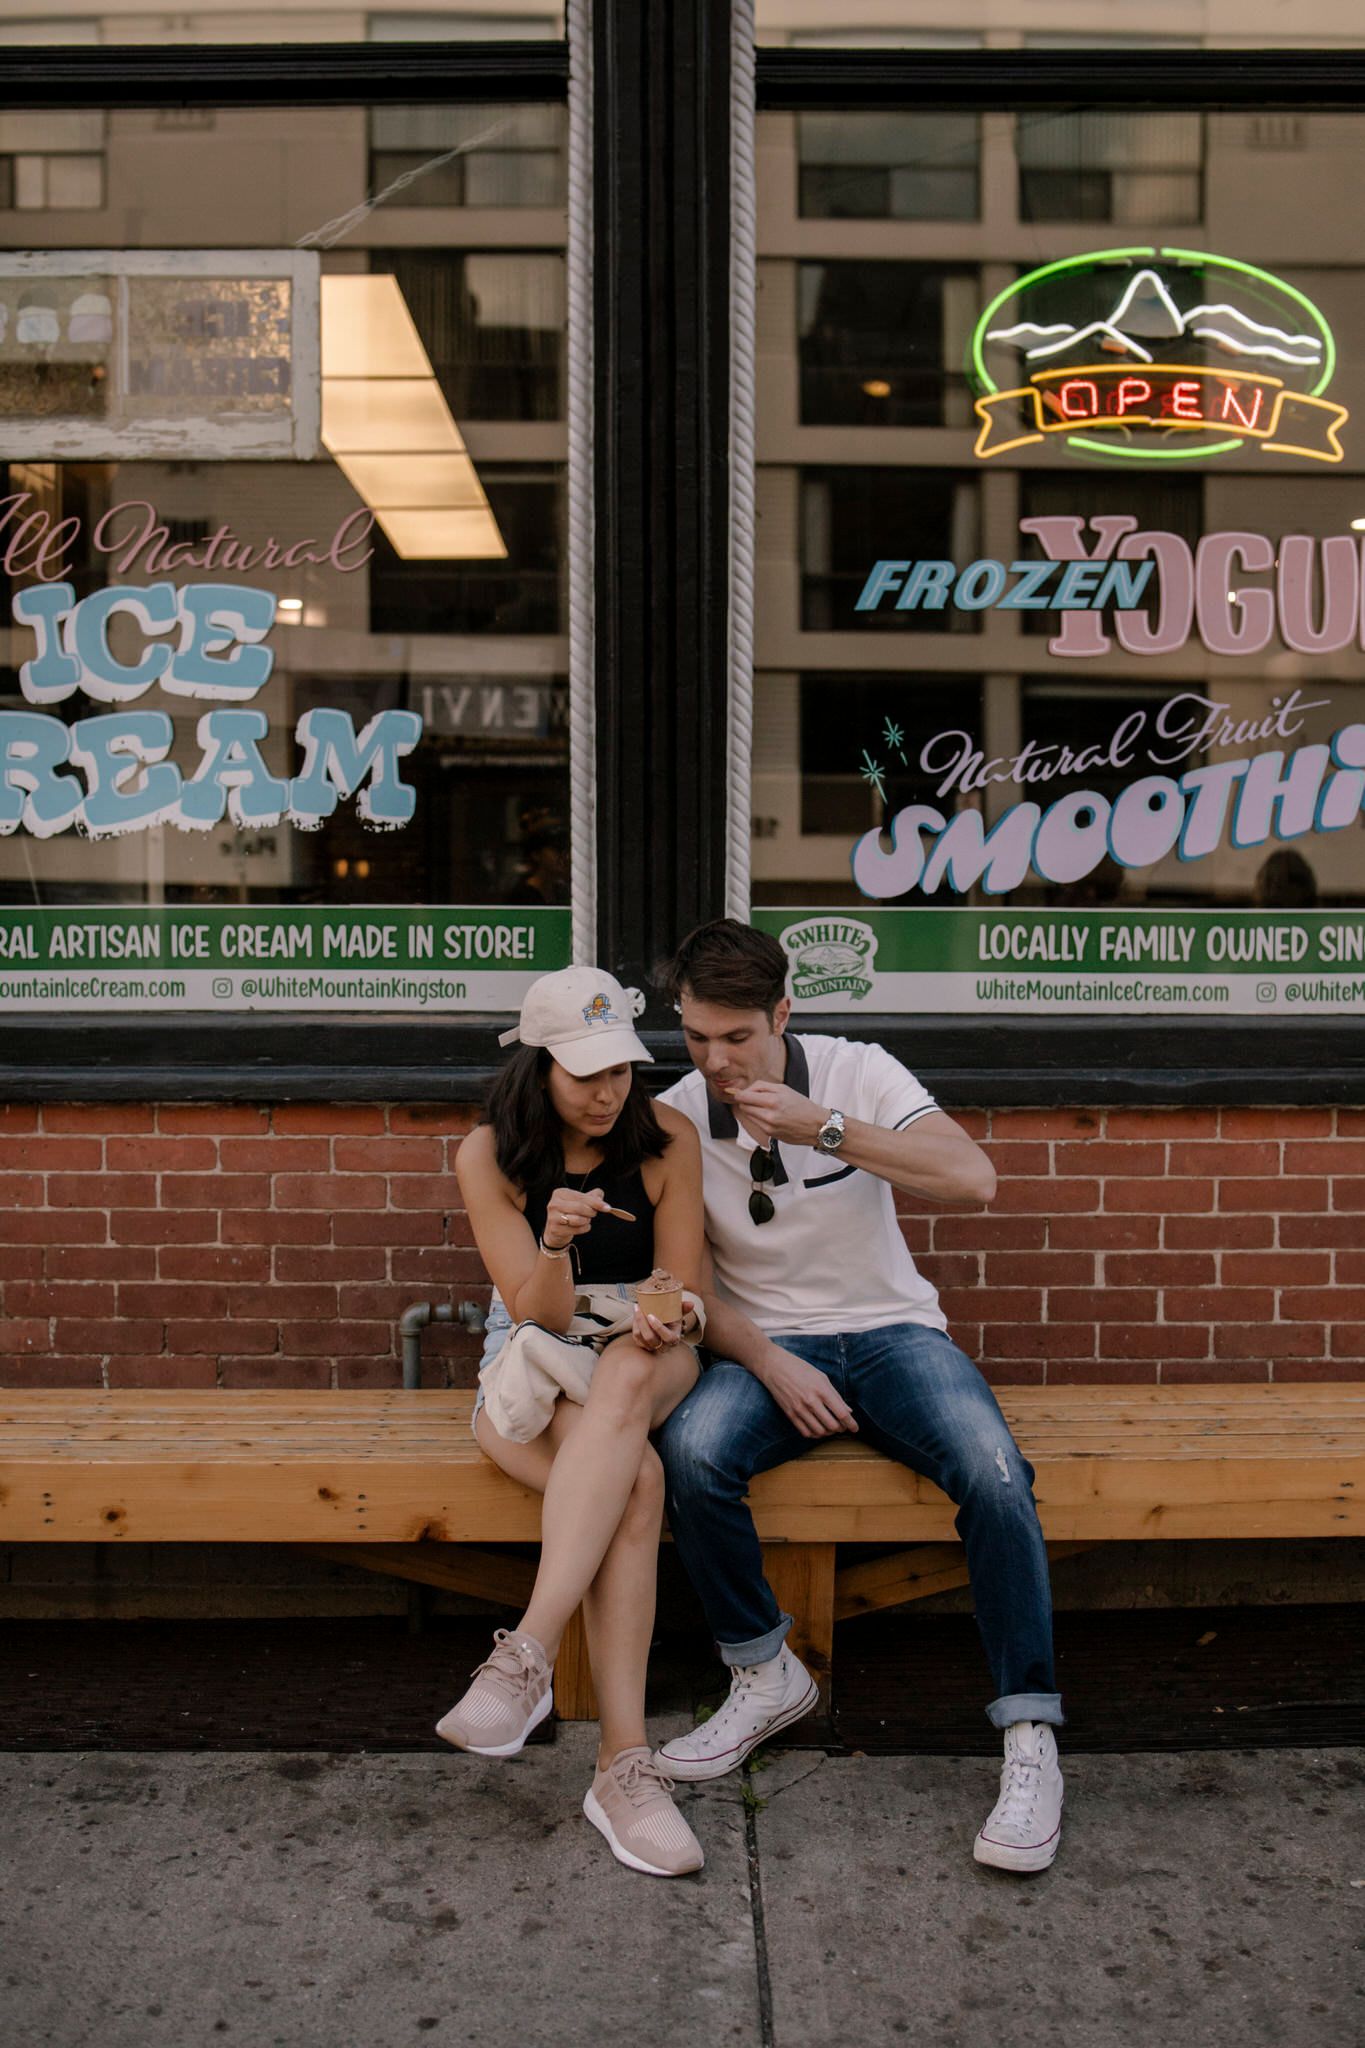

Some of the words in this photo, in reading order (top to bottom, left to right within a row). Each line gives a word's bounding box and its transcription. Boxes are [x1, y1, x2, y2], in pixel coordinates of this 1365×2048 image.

[1060, 378, 1262, 429] OPEN
[93, 501, 375, 575] Natural
[854, 560, 1155, 611] FROZEN
[1019, 515, 1365, 656] YOGU
[13, 581, 277, 704] ICE
[920, 710, 1147, 798] Natural
[1147, 689, 1331, 765] Fruit
[49, 924, 160, 959] ARTISAN
[171, 925, 210, 958] ICE
[220, 924, 312, 958] CREAM
[323, 924, 397, 958] MADE
[408, 925, 433, 959] IN
[444, 925, 535, 959] STORE!
[786, 924, 871, 955] WHITE
[978, 924, 1089, 961] LOCALLY
[1100, 925, 1196, 962] FAMILY
[1206, 926, 1309, 962] OWNED
[1318, 926, 1365, 962] SIN
[241, 977, 466, 1004] @WhiteMountainKingston
[797, 978, 869, 998] MOUNTAIN
[976, 979, 1229, 1002] WhiteMountainIceCream.com
